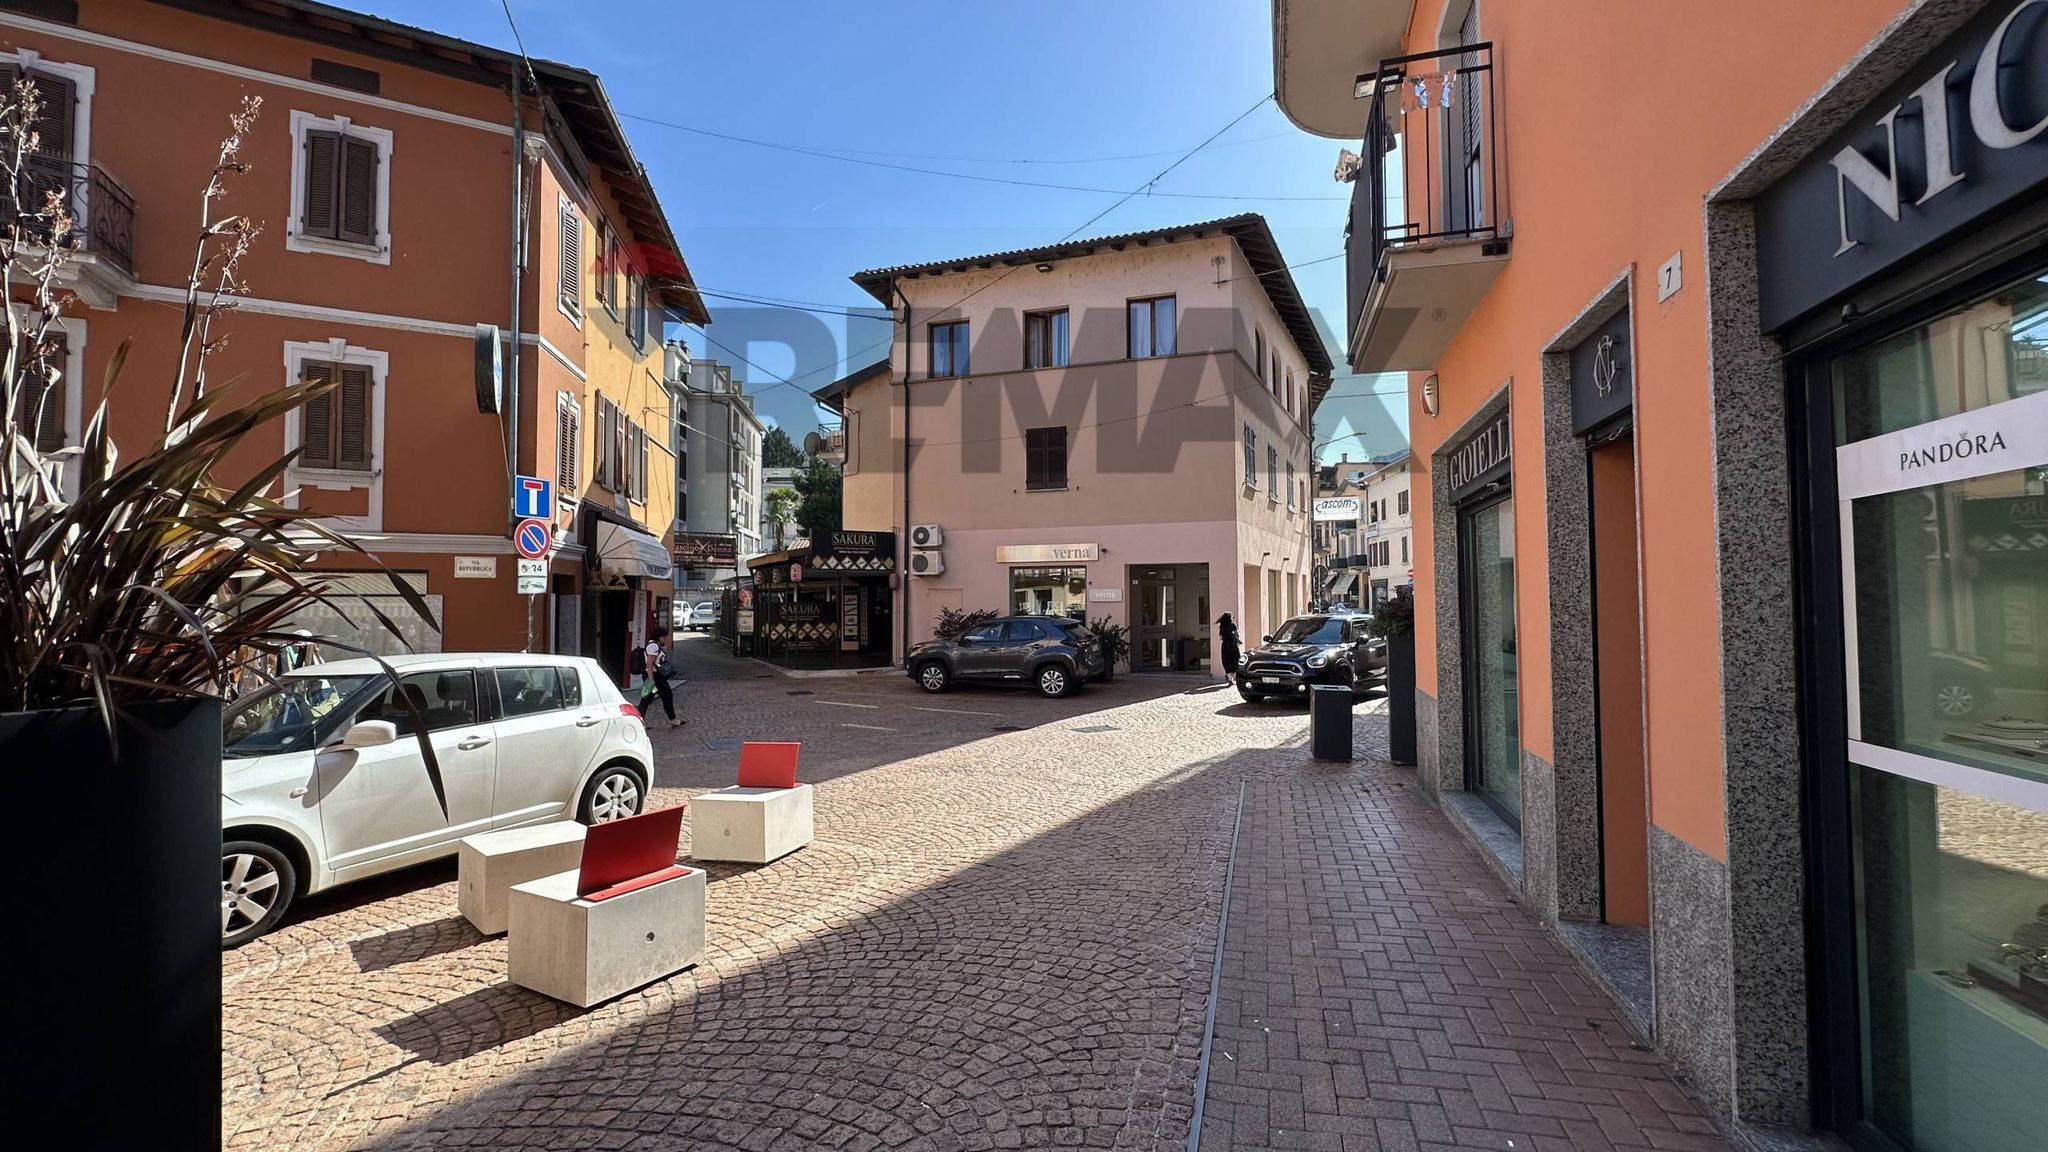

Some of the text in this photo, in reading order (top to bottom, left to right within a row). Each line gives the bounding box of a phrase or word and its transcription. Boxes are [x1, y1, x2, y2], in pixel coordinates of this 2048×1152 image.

[1665, 266, 1672, 290] 7
[1450, 414, 1511, 491] GIOIELL
[1900, 430, 2007, 471] PANDORA
[1321, 498, 1352, 509] ascom
[833, 533, 875, 545] SAKURA
[1053, 547, 1090, 559] verna
[1094, 591, 1116, 600] verna
[781, 604, 820, 615] SAKURA
